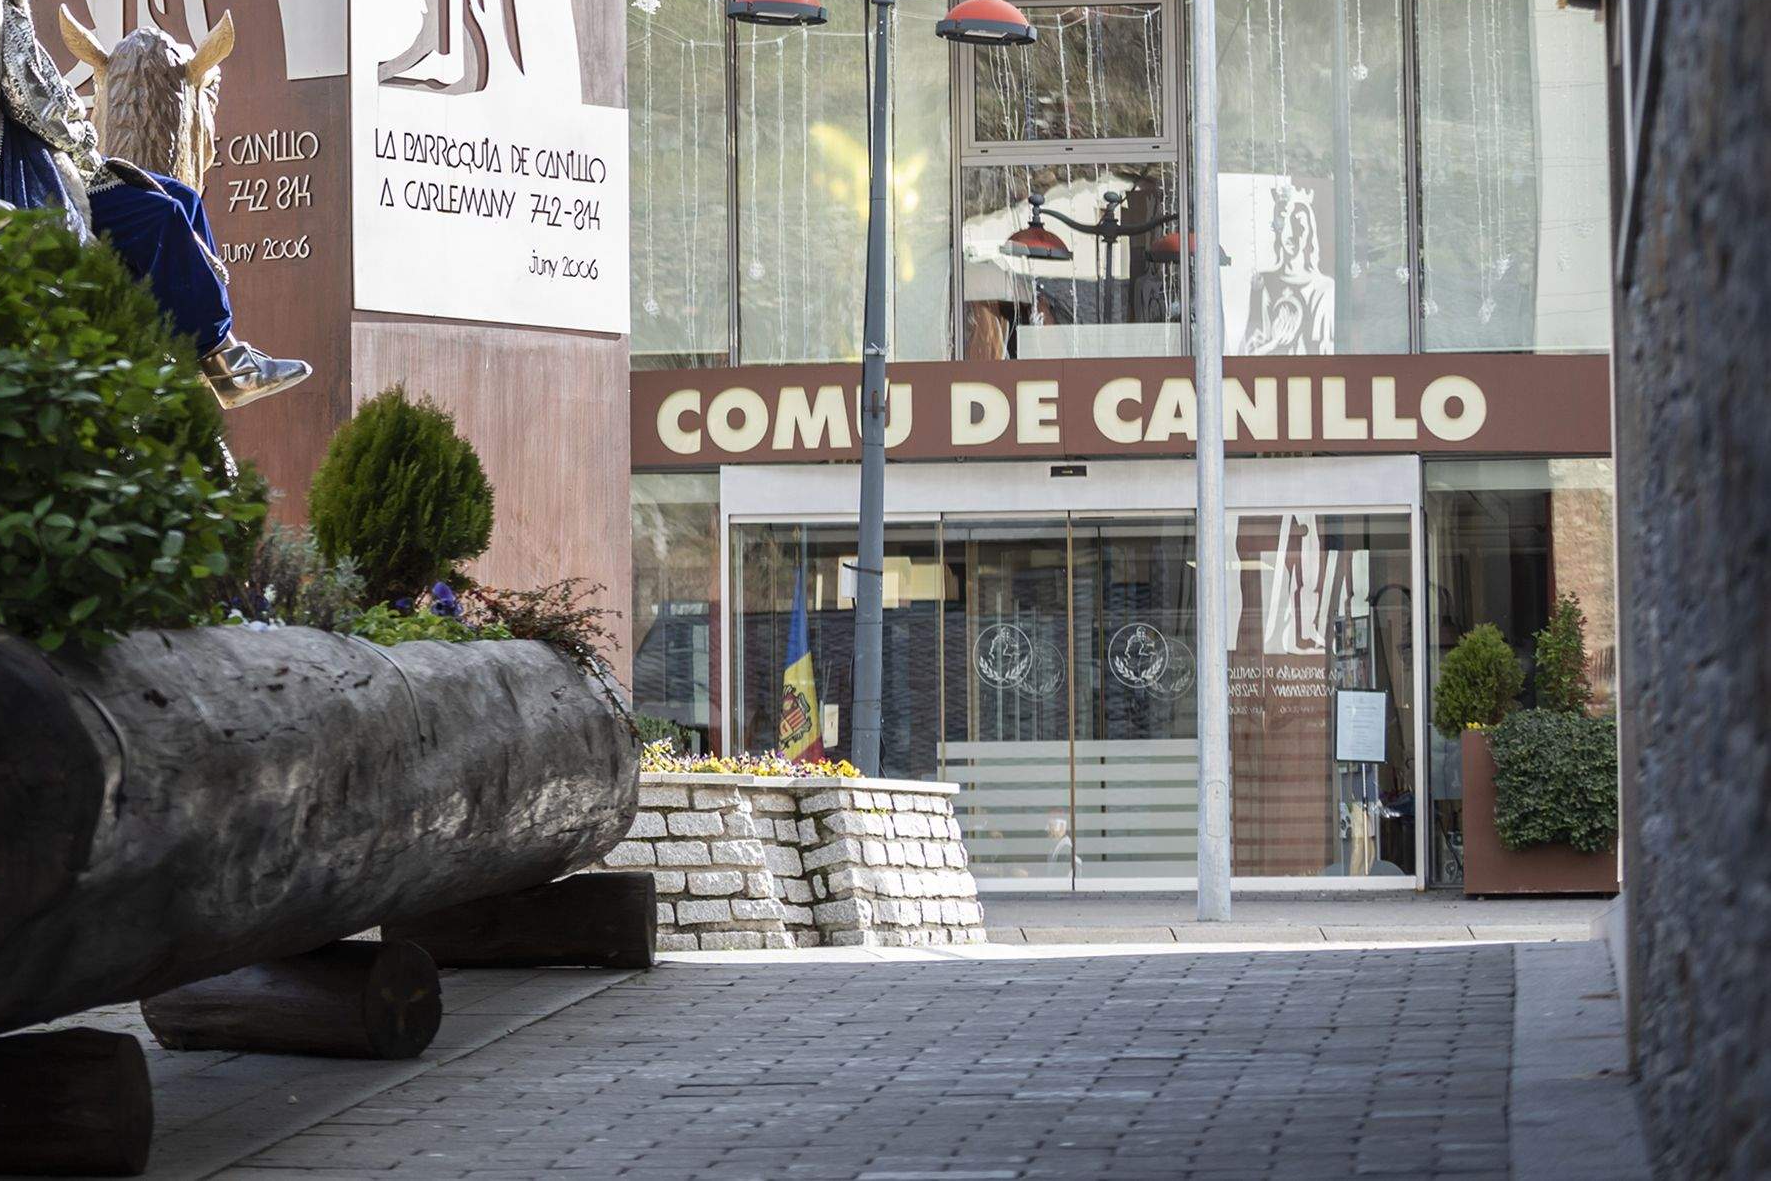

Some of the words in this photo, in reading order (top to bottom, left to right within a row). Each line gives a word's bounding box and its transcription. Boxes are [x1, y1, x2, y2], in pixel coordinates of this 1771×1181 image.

[228, 129, 320, 165] CANILLO
[374, 127, 397, 160] LA
[511, 144, 531, 176] DE
[535, 149, 606, 184] CANILLO
[228, 178, 270, 213] 742
[276, 174, 312, 210] 84
[380, 177, 395, 207] A
[403, 180, 517, 220] CARLEMANY
[262, 235, 311, 261] 2006
[528, 249, 559, 279] juny
[562, 255, 599, 280] 2006
[950, 379, 1061, 446] DE
[1092, 374, 1488, 444] CANILLO
